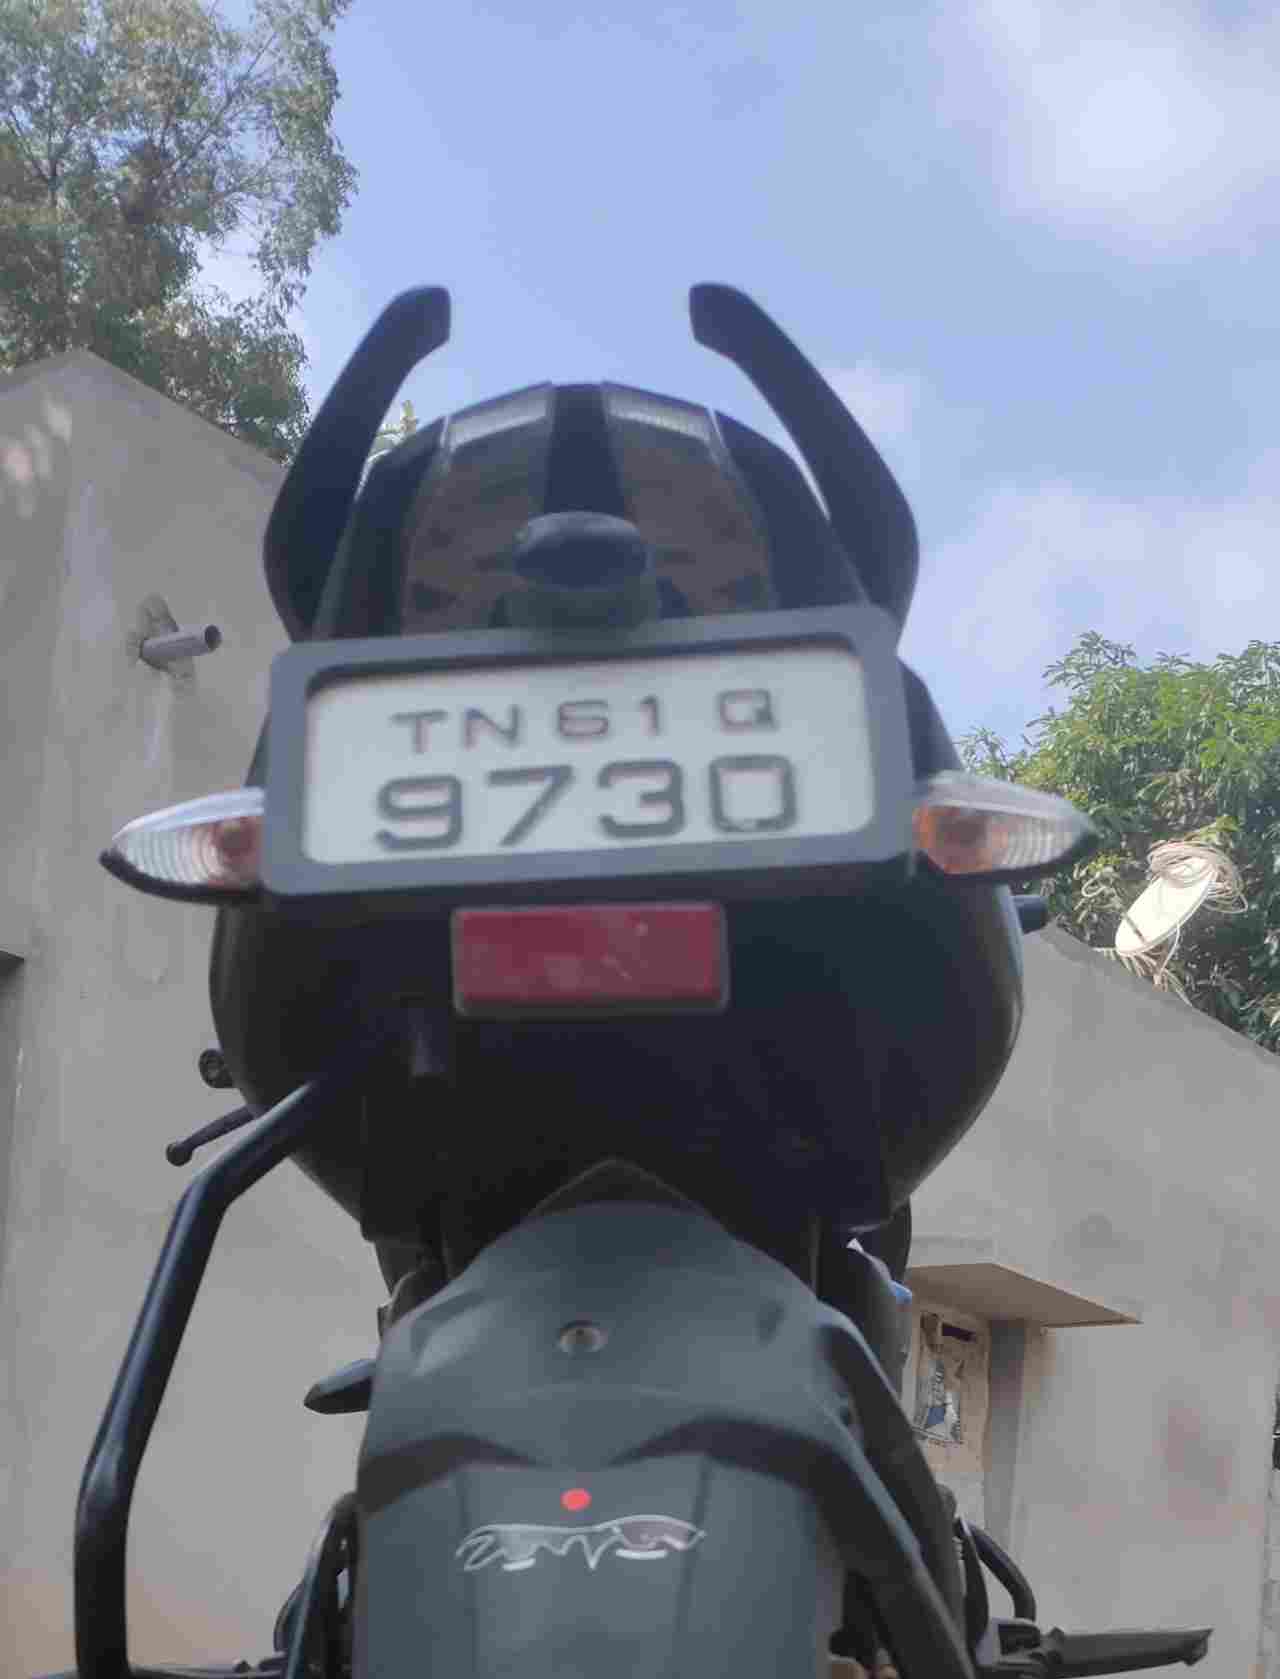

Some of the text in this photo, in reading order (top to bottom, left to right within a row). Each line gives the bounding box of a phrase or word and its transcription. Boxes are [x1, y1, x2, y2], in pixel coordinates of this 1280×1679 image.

[391, 689, 778, 753] TN 61 Q
[375, 755, 798, 851] 9730
